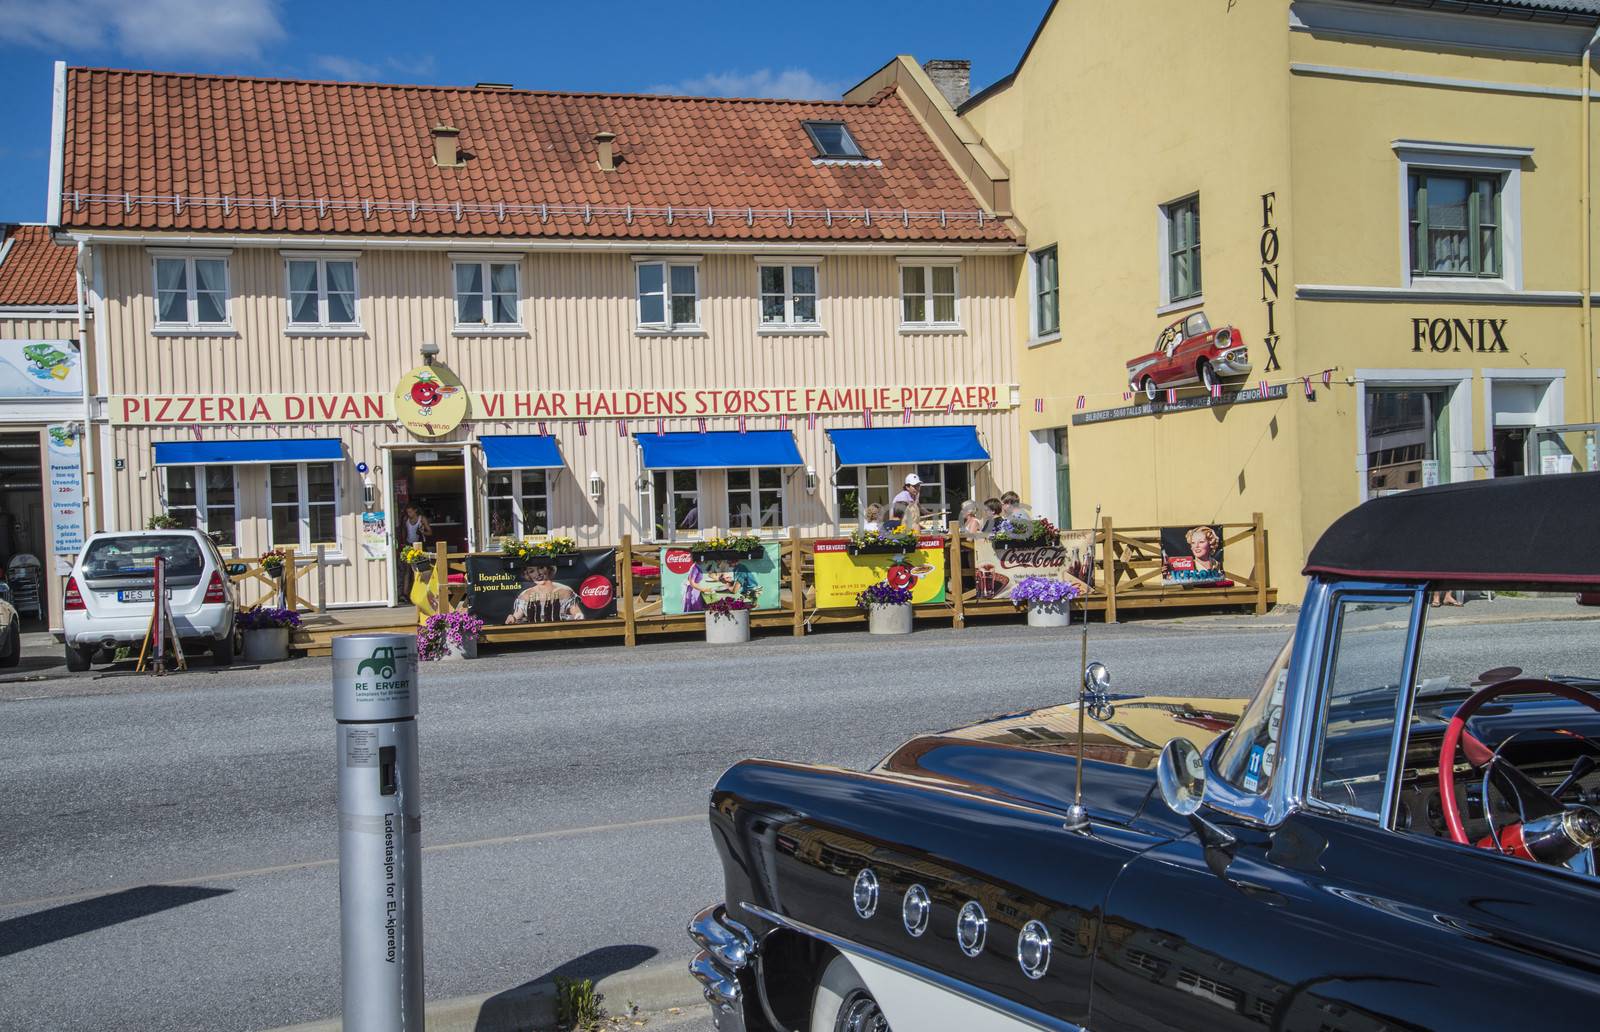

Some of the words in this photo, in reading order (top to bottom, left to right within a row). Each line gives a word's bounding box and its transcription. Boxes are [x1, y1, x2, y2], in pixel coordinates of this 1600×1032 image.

[1260, 192, 1281, 372] FØNIX
[1411, 317, 1510, 353] FØNIX
[122, 397, 272, 423] PIZZERIA
[284, 395, 384, 420] DIVAN
[480, 393, 505, 417] VI
[514, 393, 568, 417] HAR
[575, 391, 688, 416] HALDENS
[695, 388, 797, 414] STØRSTE
[1000, 547, 1066, 569] Coca-Cola
[474, 584, 481, 592] in
[482, 585, 499, 593] your
[500, 582, 522, 591] hands
[479, 572, 516, 583] Hospitality
[124, 590, 143, 599] WES
[581, 585, 610, 597] Coca-Cola
[1249, 752, 1260, 775] 11
[384, 812, 395, 880] Ladestasjon
[386, 882, 395, 898] for
[385, 901, 397, 963] EL-kjøretøy
